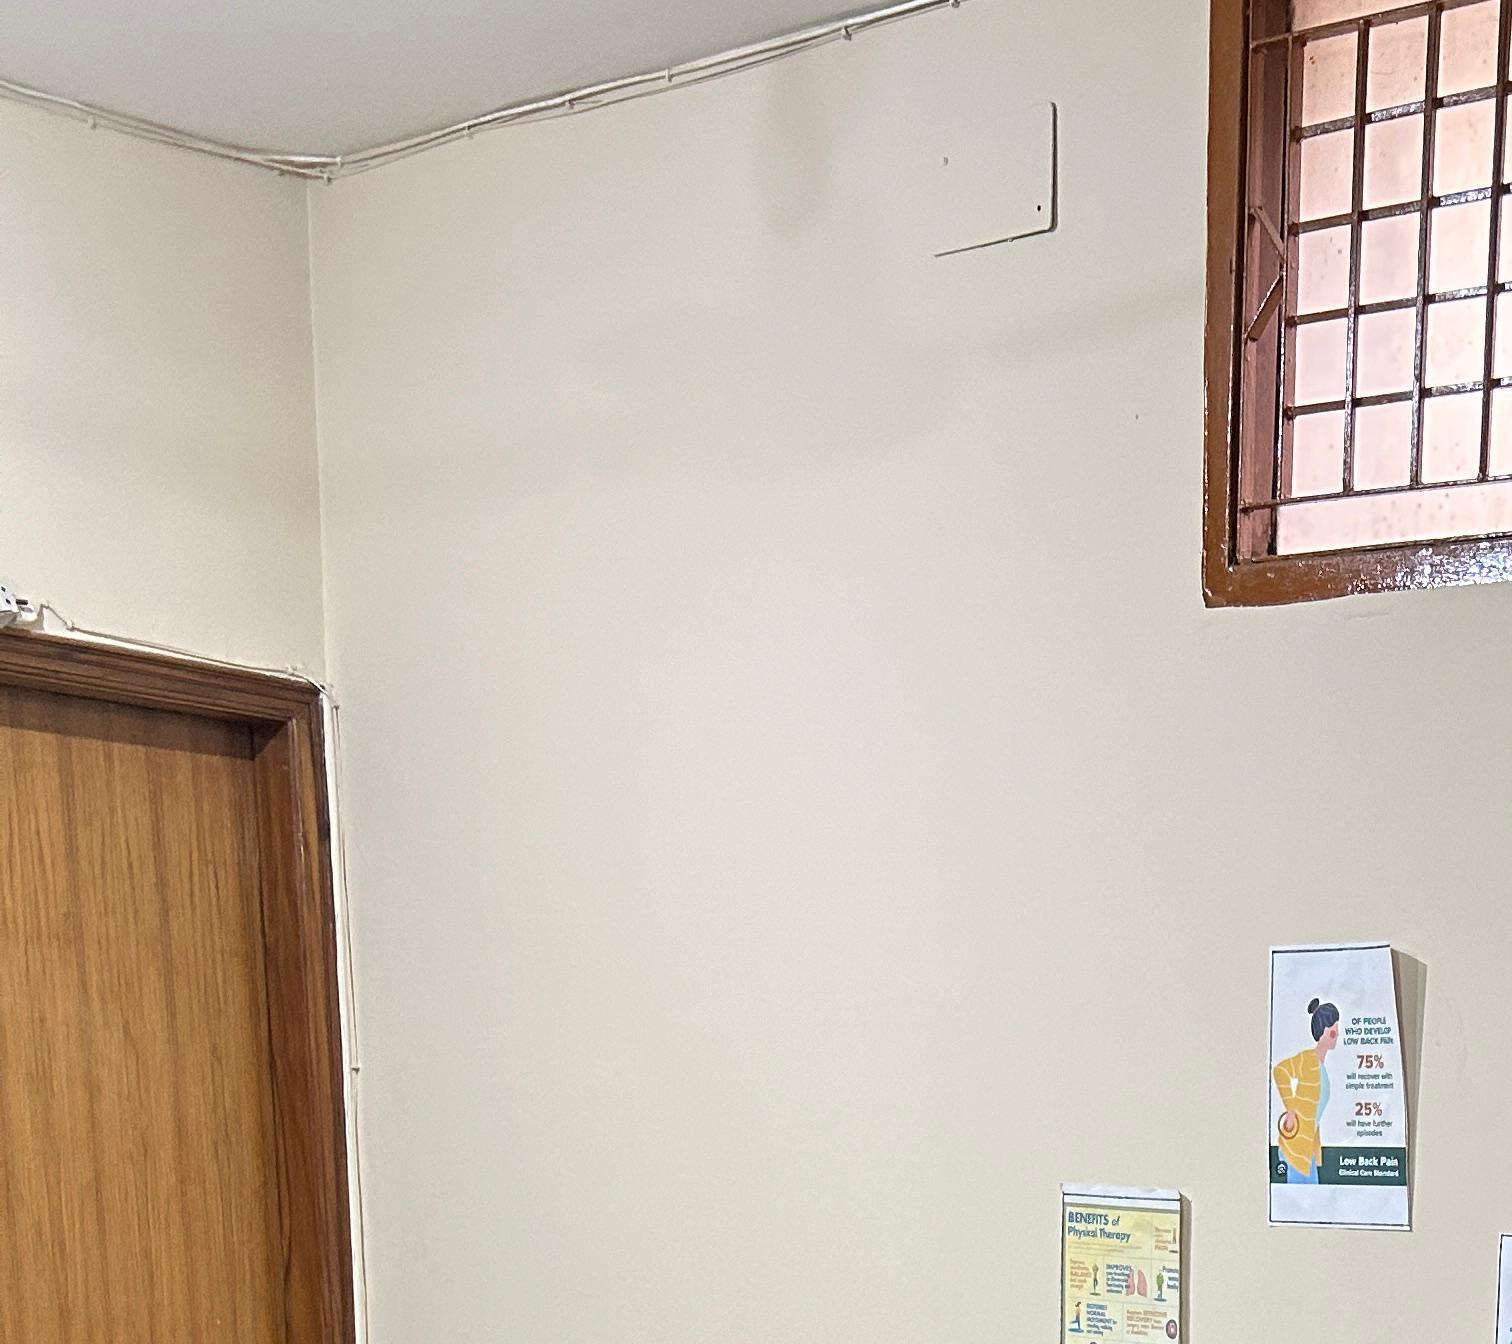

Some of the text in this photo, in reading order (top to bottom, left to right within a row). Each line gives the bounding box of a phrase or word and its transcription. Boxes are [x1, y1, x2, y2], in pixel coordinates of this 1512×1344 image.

[1343, 1037, 1359, 1046] LOW
[1360, 1037, 1379, 1045] BACK
[1356, 1054, 1385, 1070] 75%
[1354, 1102, 1383, 1117] 25%
[1339, 1156, 1399, 1168] Low Back Pain
[1068, 1211, 1121, 1226] BENEFITS of
[1067, 1226, 1131, 1243] Physical Therapy
